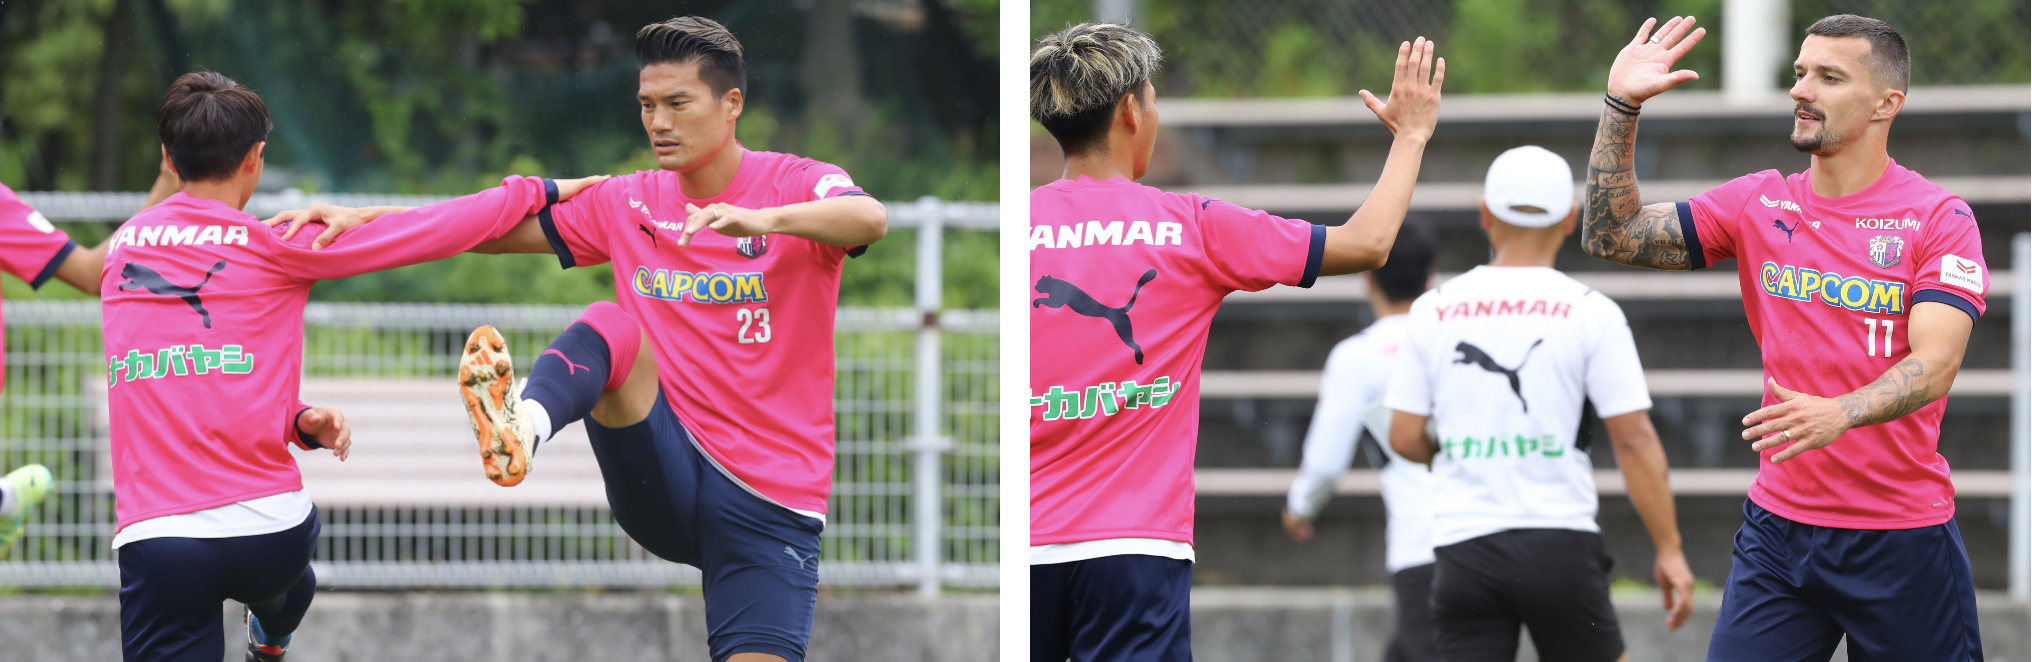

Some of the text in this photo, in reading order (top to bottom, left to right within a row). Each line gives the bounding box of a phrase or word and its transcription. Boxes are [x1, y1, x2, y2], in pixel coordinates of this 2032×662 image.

[1030, 220, 1183, 250] ANMAR
[1855, 217, 1921, 232] KOIZUMI
[633, 265, 768, 304] CAPCOM
[1760, 261, 1905, 315] CAPCOM
[736, 308, 772, 344] 23
[1436, 299, 1572, 322] YANMAR
[1864, 318, 1894, 358] 11
[108, 344, 254, 389] ナカバヤシ
